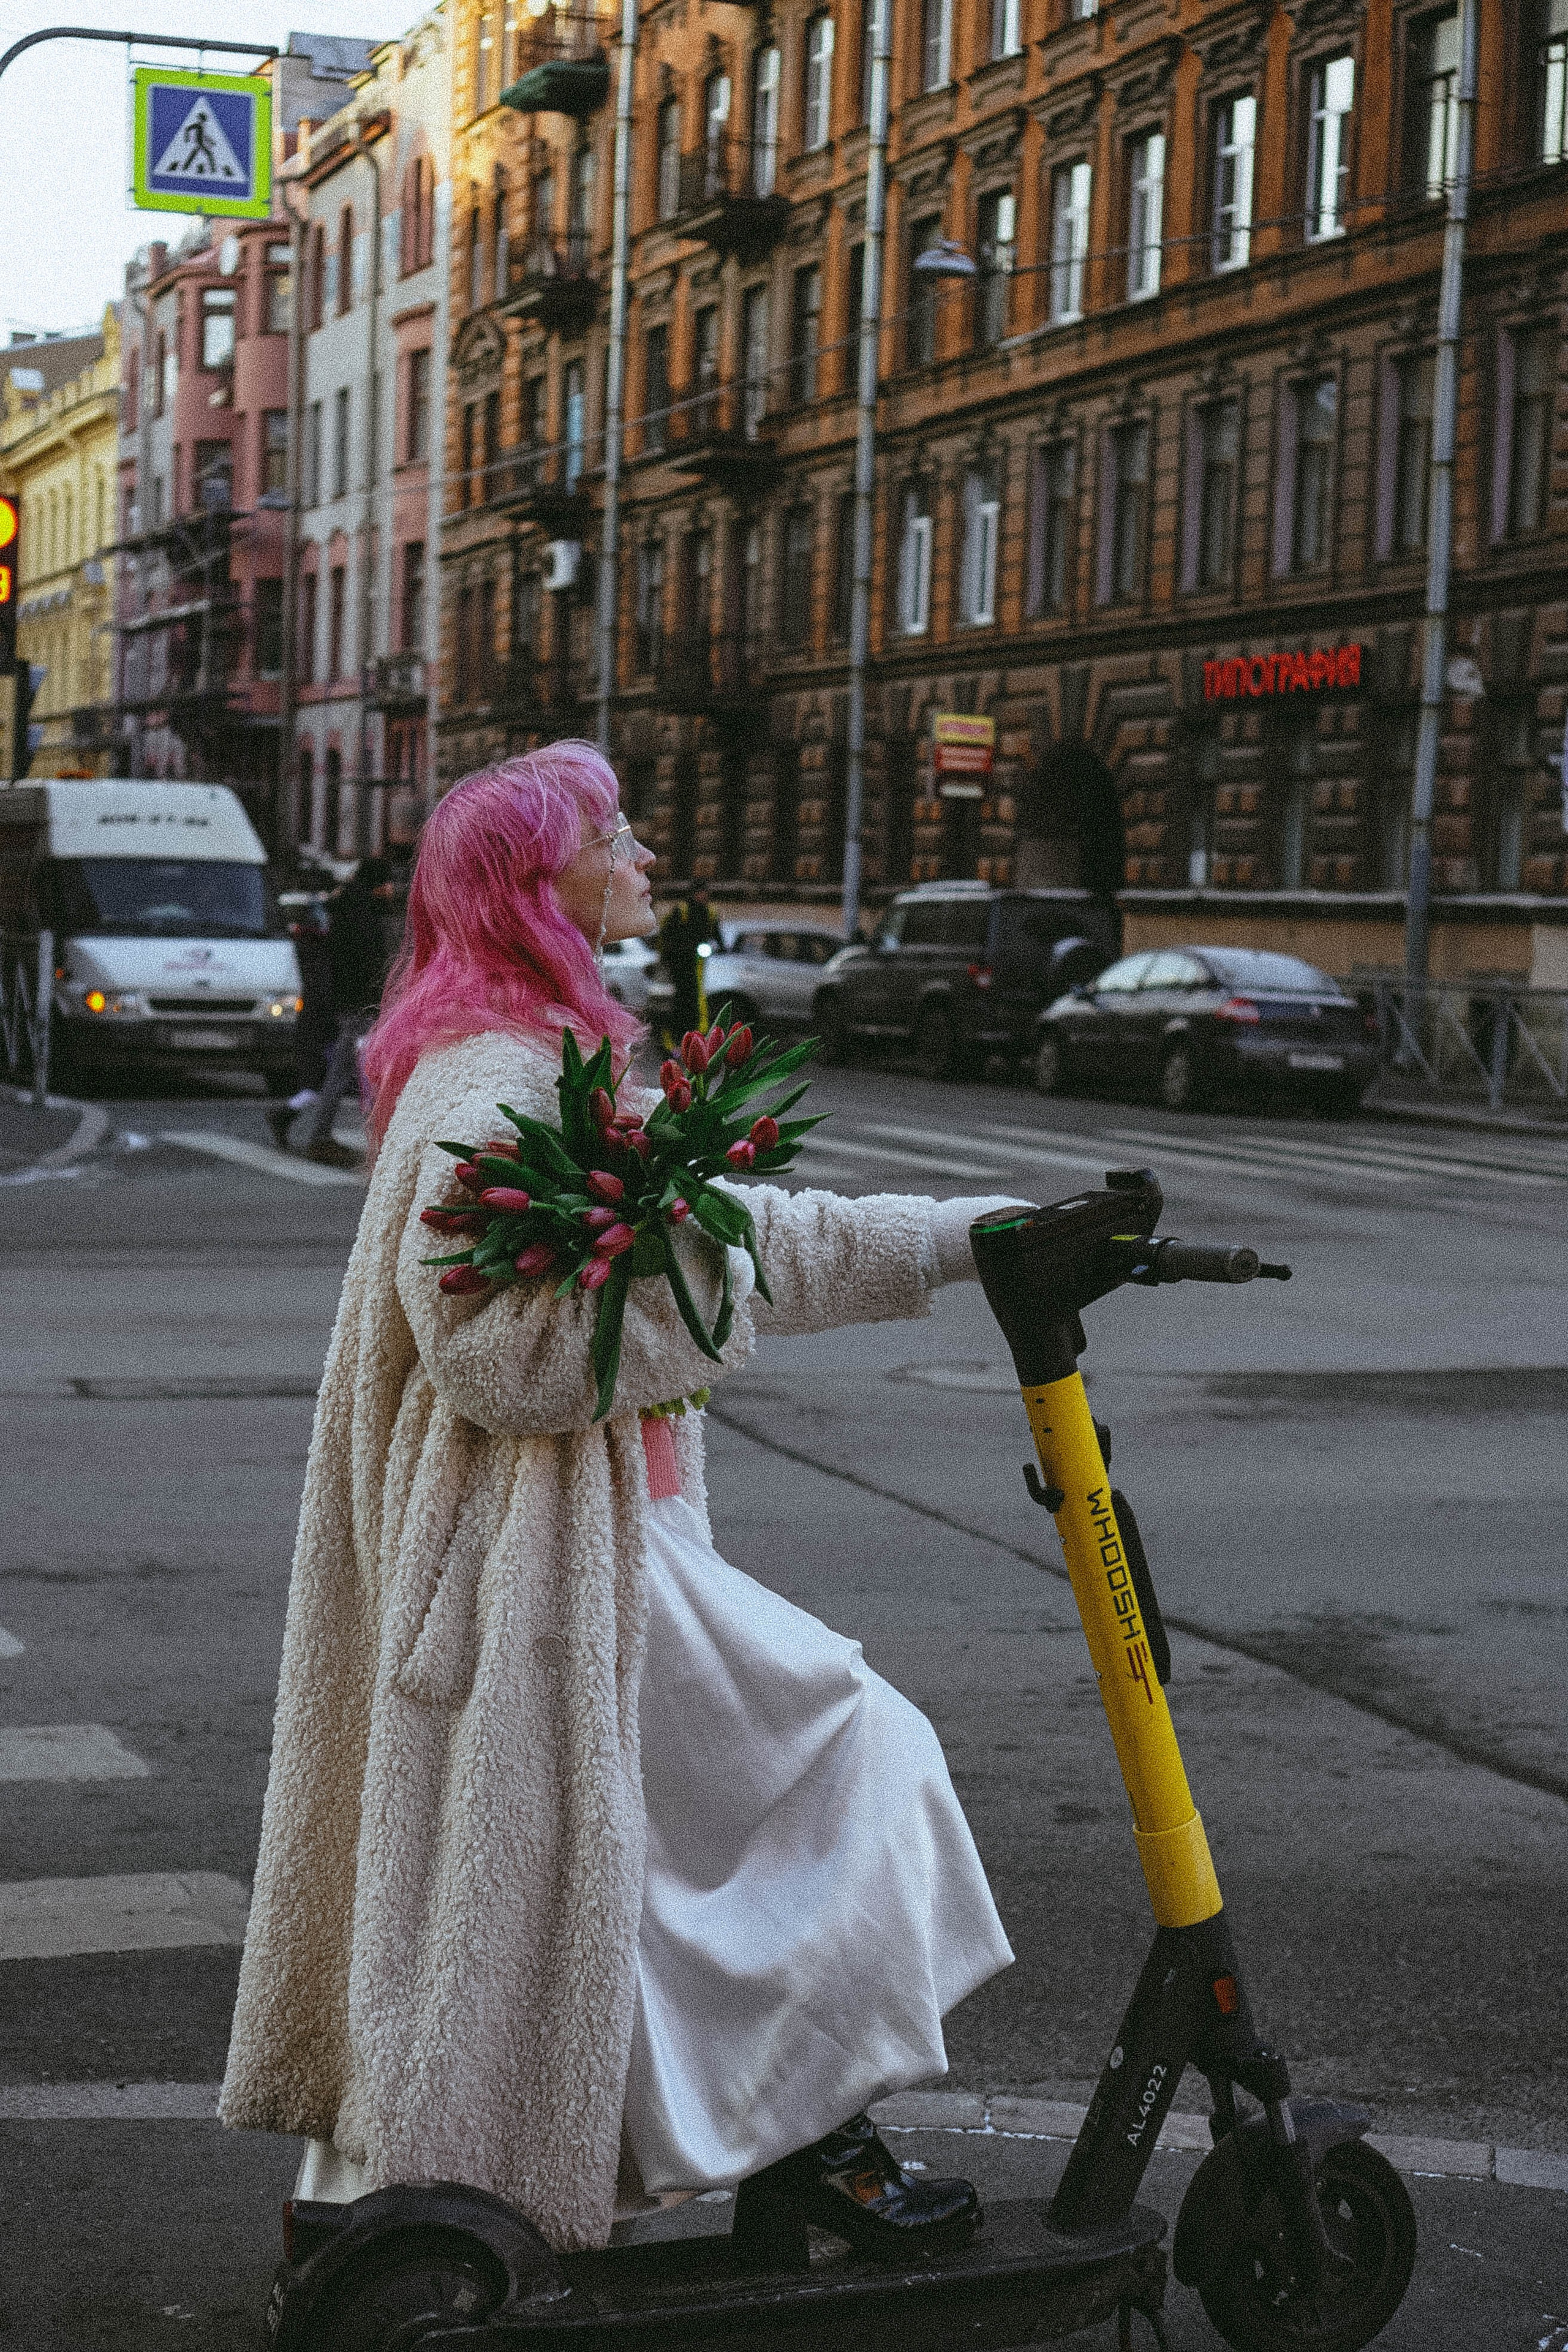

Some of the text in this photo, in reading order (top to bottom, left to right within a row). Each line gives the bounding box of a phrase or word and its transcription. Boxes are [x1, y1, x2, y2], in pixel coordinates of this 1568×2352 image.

[1204, 644, 1361, 700] ТИПОГРАФИЯ
[1087, 1487, 1141, 1641] WHOOSH
[1127, 2065, 1167, 2147] AL4022
